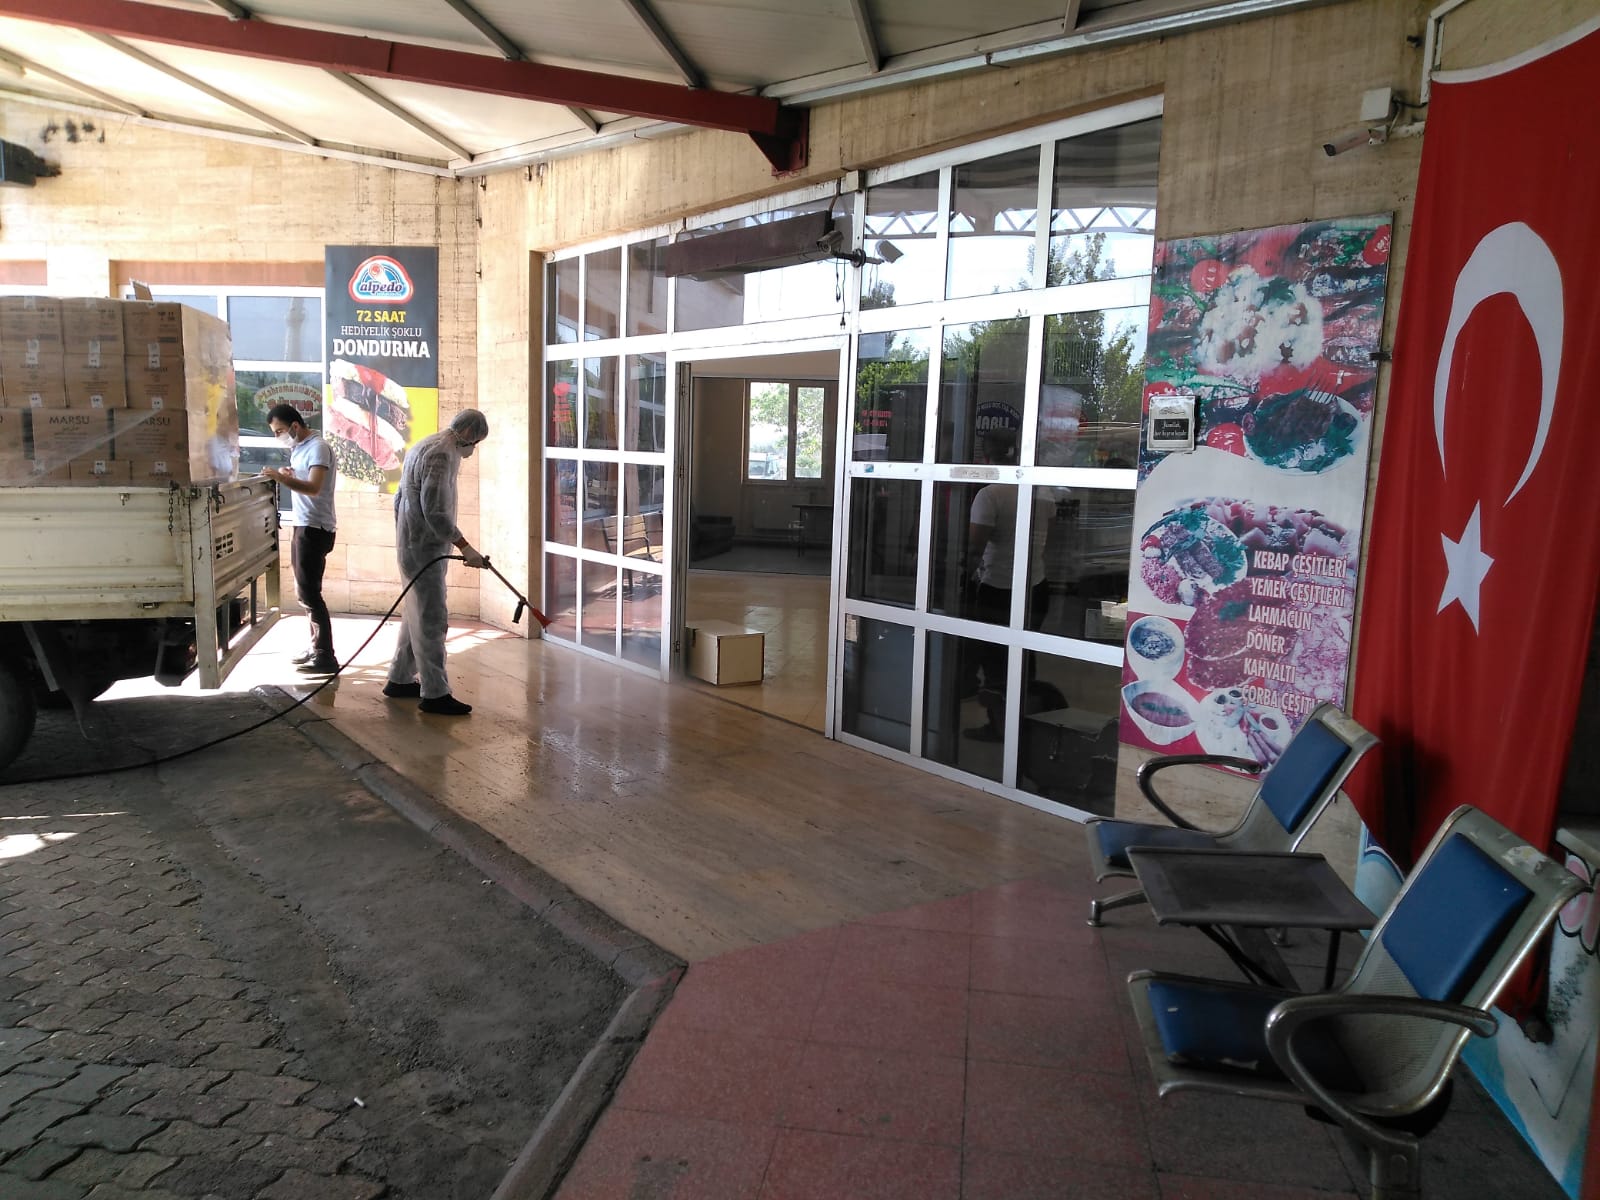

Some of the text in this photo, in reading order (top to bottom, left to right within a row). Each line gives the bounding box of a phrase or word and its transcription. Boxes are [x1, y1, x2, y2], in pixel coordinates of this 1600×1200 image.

[359, 280, 403, 294] alpedo
[356, 310, 407, 323] 72 SAAT
[341, 324, 422, 339] HEDİYELİK ŞOKLU
[332, 338, 431, 358] DONDURMA
[49, 415, 90, 425] MARSU
[1253, 550, 1348, 579] KEBAP ÇEŞİTLERİ
[1251, 577, 1345, 608] YEMEK ÇEŞİTLERİ
[1248, 604, 1312, 631] LAHMACUN
[1246, 628, 1286, 654] DÖNER
[1243, 657, 1297, 684] KAHVALTI
[1241, 685, 1279, 708] ÇORBA
